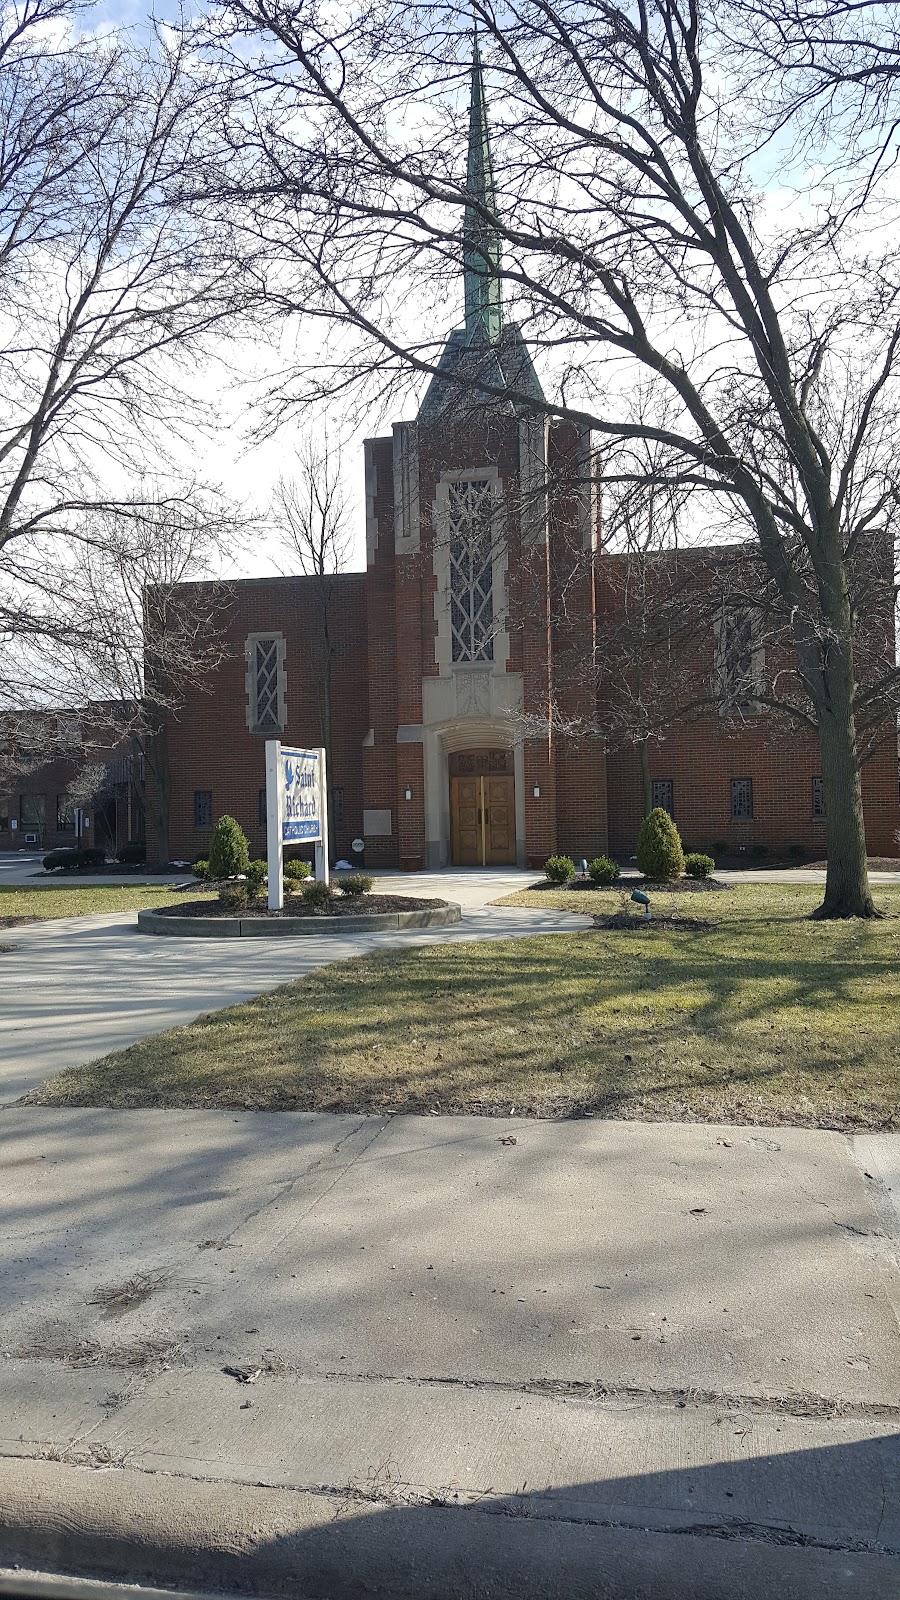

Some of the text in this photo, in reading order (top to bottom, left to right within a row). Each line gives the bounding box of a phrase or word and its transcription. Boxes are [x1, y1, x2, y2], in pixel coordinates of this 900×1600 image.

[296, 765, 315, 788] Saint
[286, 795, 316, 818] Richard
[284, 825, 318, 836] CATHOLIC CHURCH
